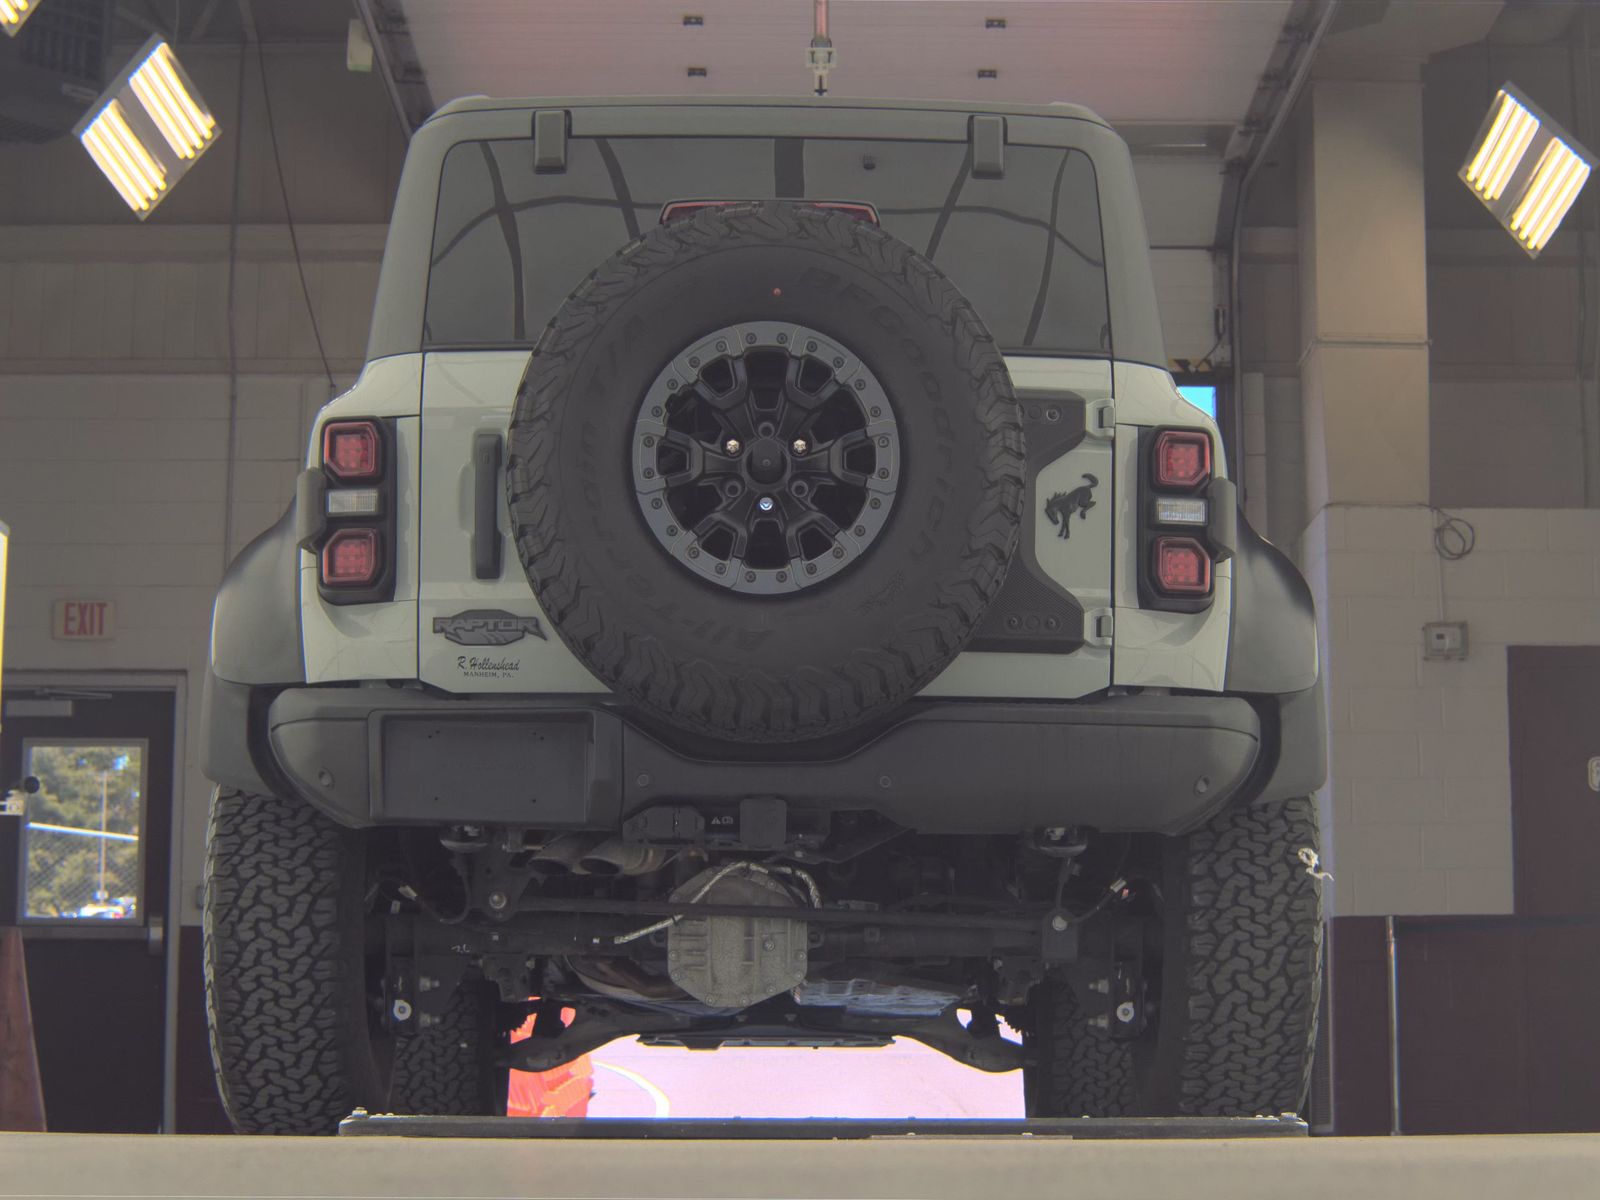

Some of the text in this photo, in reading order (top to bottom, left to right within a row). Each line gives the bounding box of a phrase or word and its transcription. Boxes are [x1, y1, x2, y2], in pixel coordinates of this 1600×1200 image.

[64, 602, 107, 635] EXIT
[433, 616, 547, 641] RAPTOR
[469, 656, 520, 671] Hollenshead
[463, 671, 500, 679] MANHEIM,
